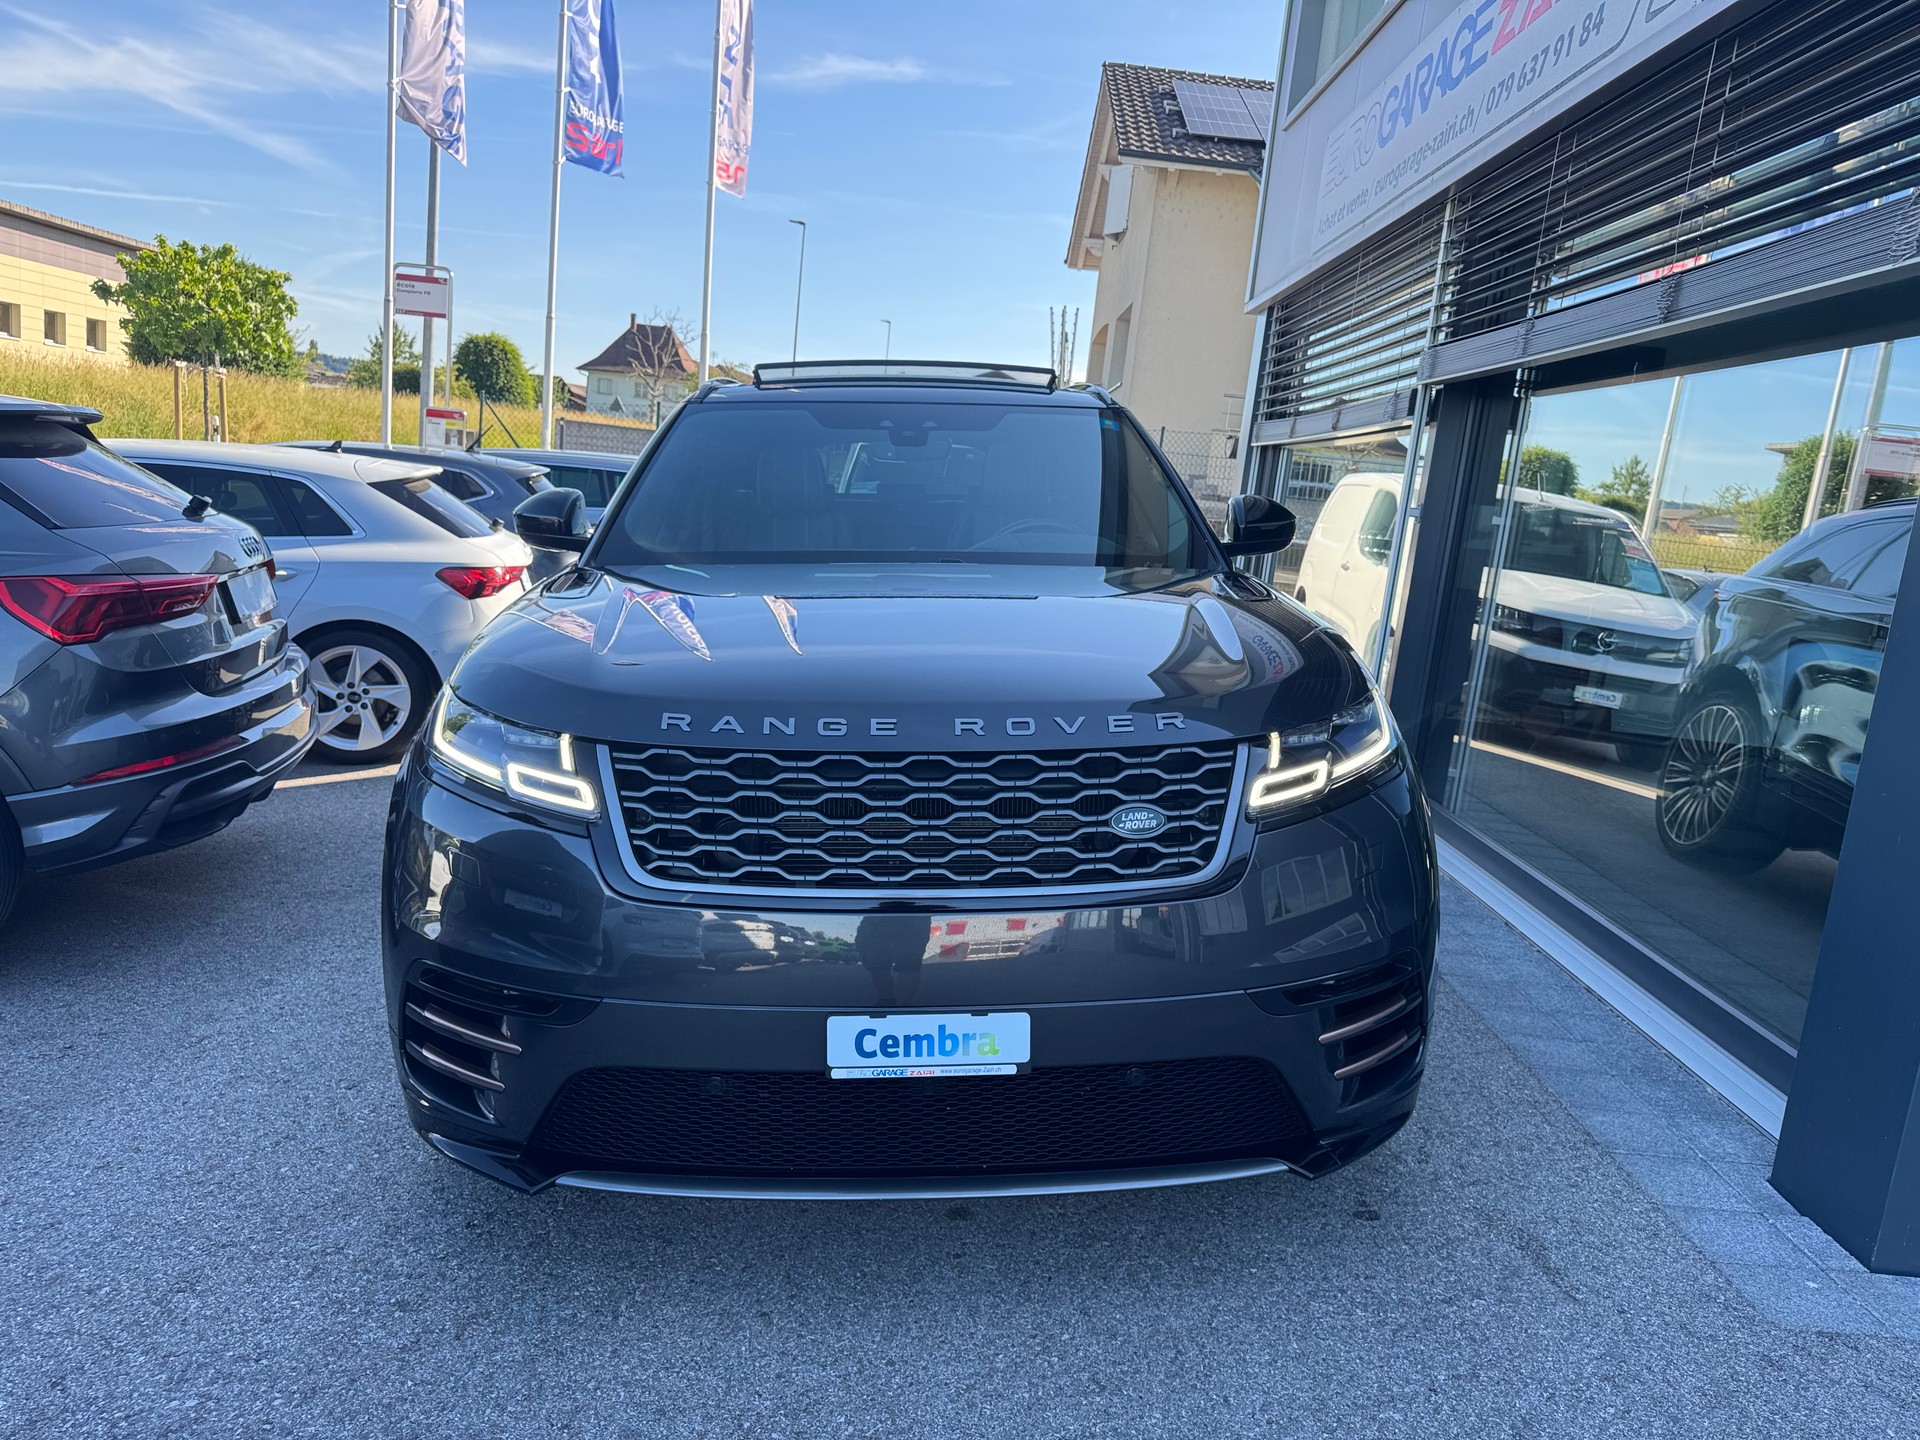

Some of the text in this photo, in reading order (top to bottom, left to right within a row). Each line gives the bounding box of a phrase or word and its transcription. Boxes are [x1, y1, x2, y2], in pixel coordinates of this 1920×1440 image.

[1347, 187, 1368, 217] vente
[1375, 104, 1475, 197] eurogarage-zairi.ch
[1486, 71, 1515, 115] 079
[1516, 44, 1550, 93] 637
[1552, 24, 1576, 68] 91
[1578, 1, 1606, 48] 84
[661, 711, 1188, 737] RANGE ROVER
[854, 1024, 1000, 1059] Cembra
